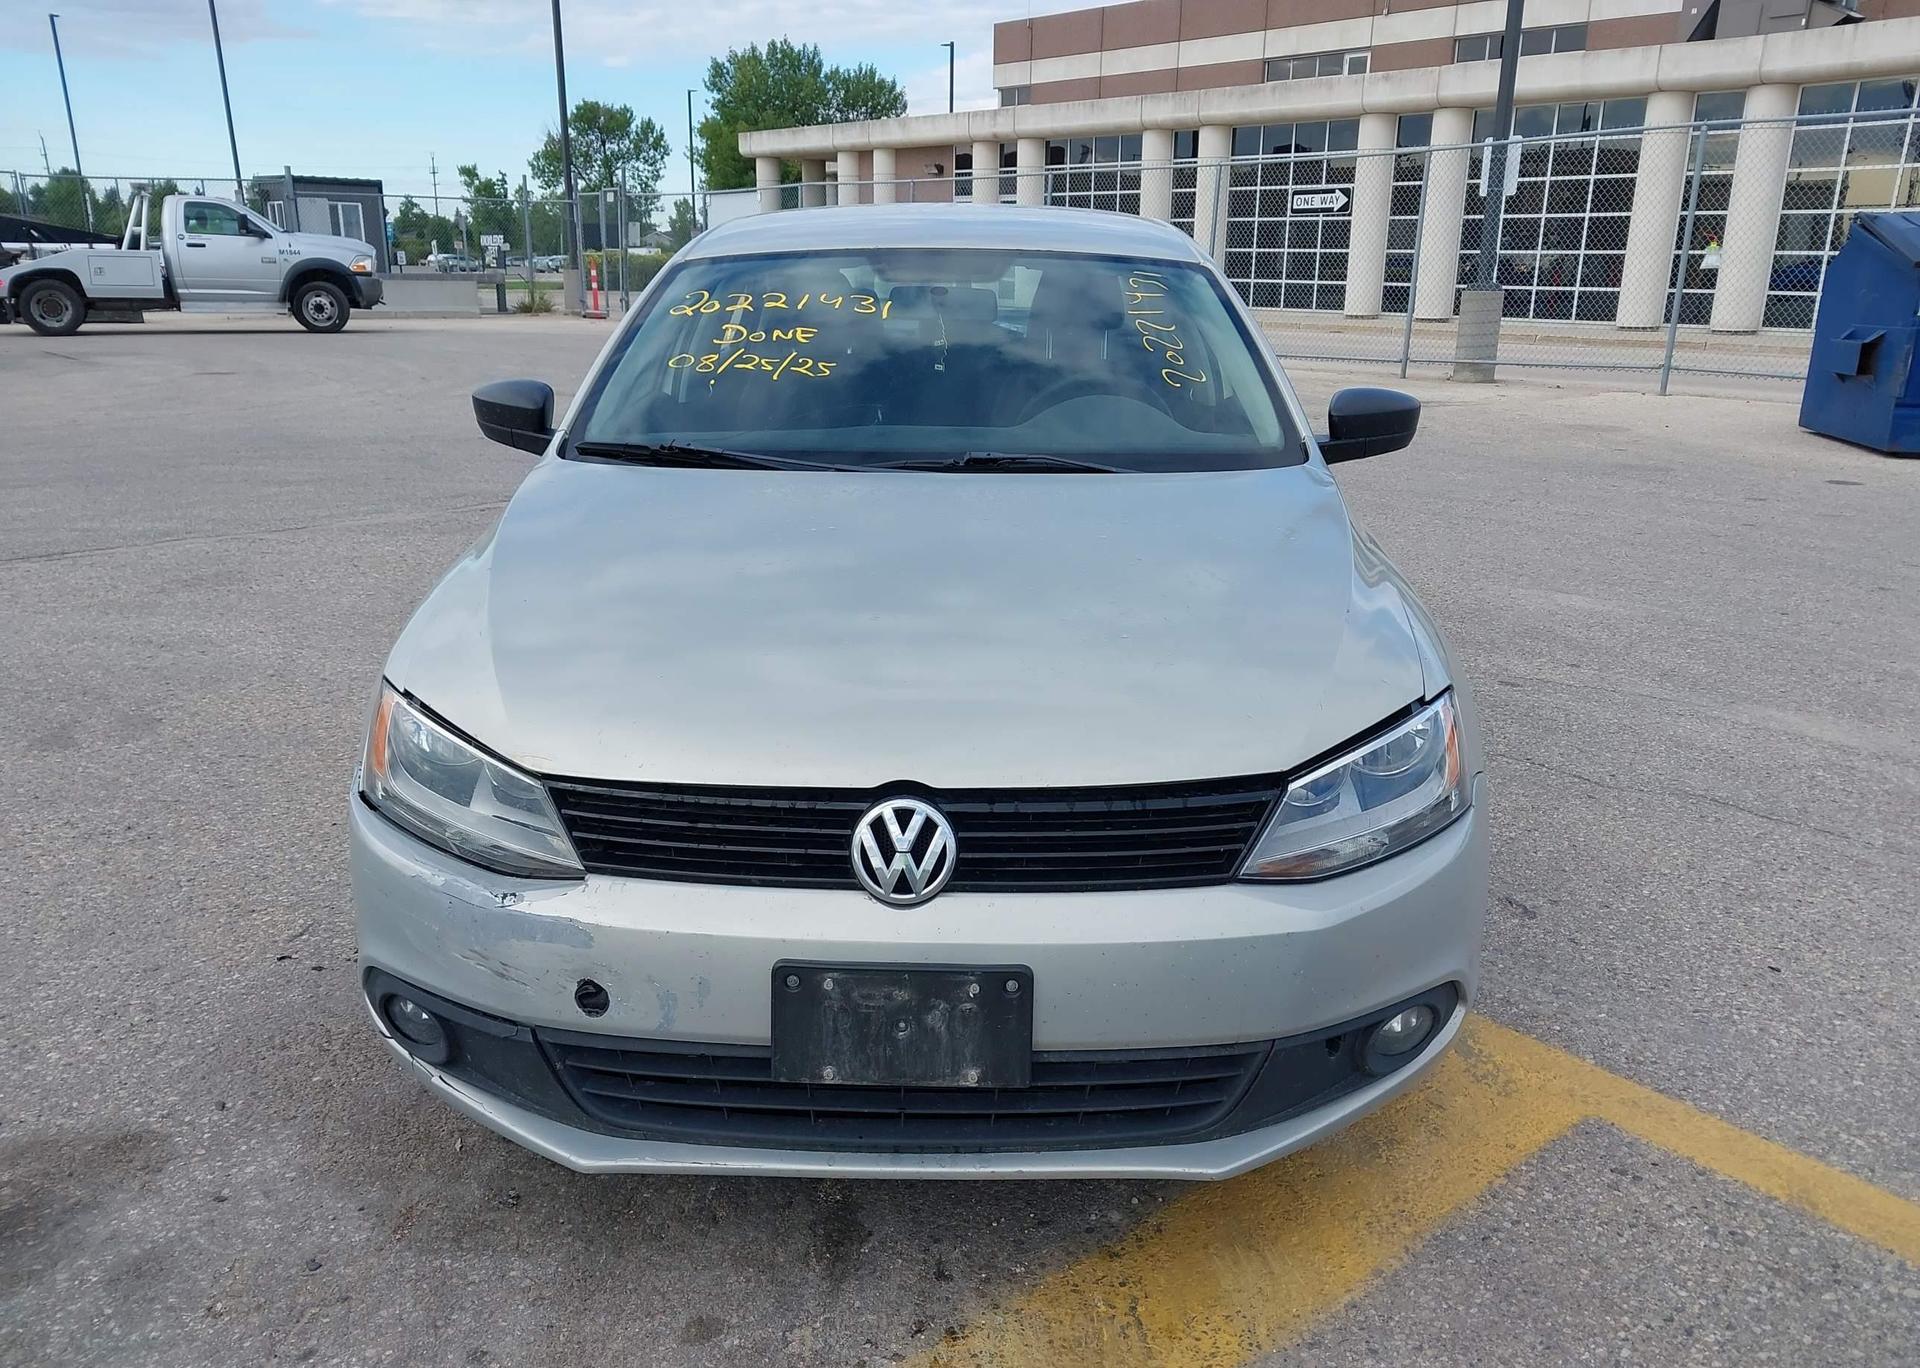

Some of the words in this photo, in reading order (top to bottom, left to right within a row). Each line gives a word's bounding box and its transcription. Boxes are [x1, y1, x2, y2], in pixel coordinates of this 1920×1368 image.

[1296, 196, 1315, 207] ONE
[1320, 195, 1340, 205] WAY
[669, 290, 893, 320] 20221431
[668, 348, 837, 380] 08/25/25
